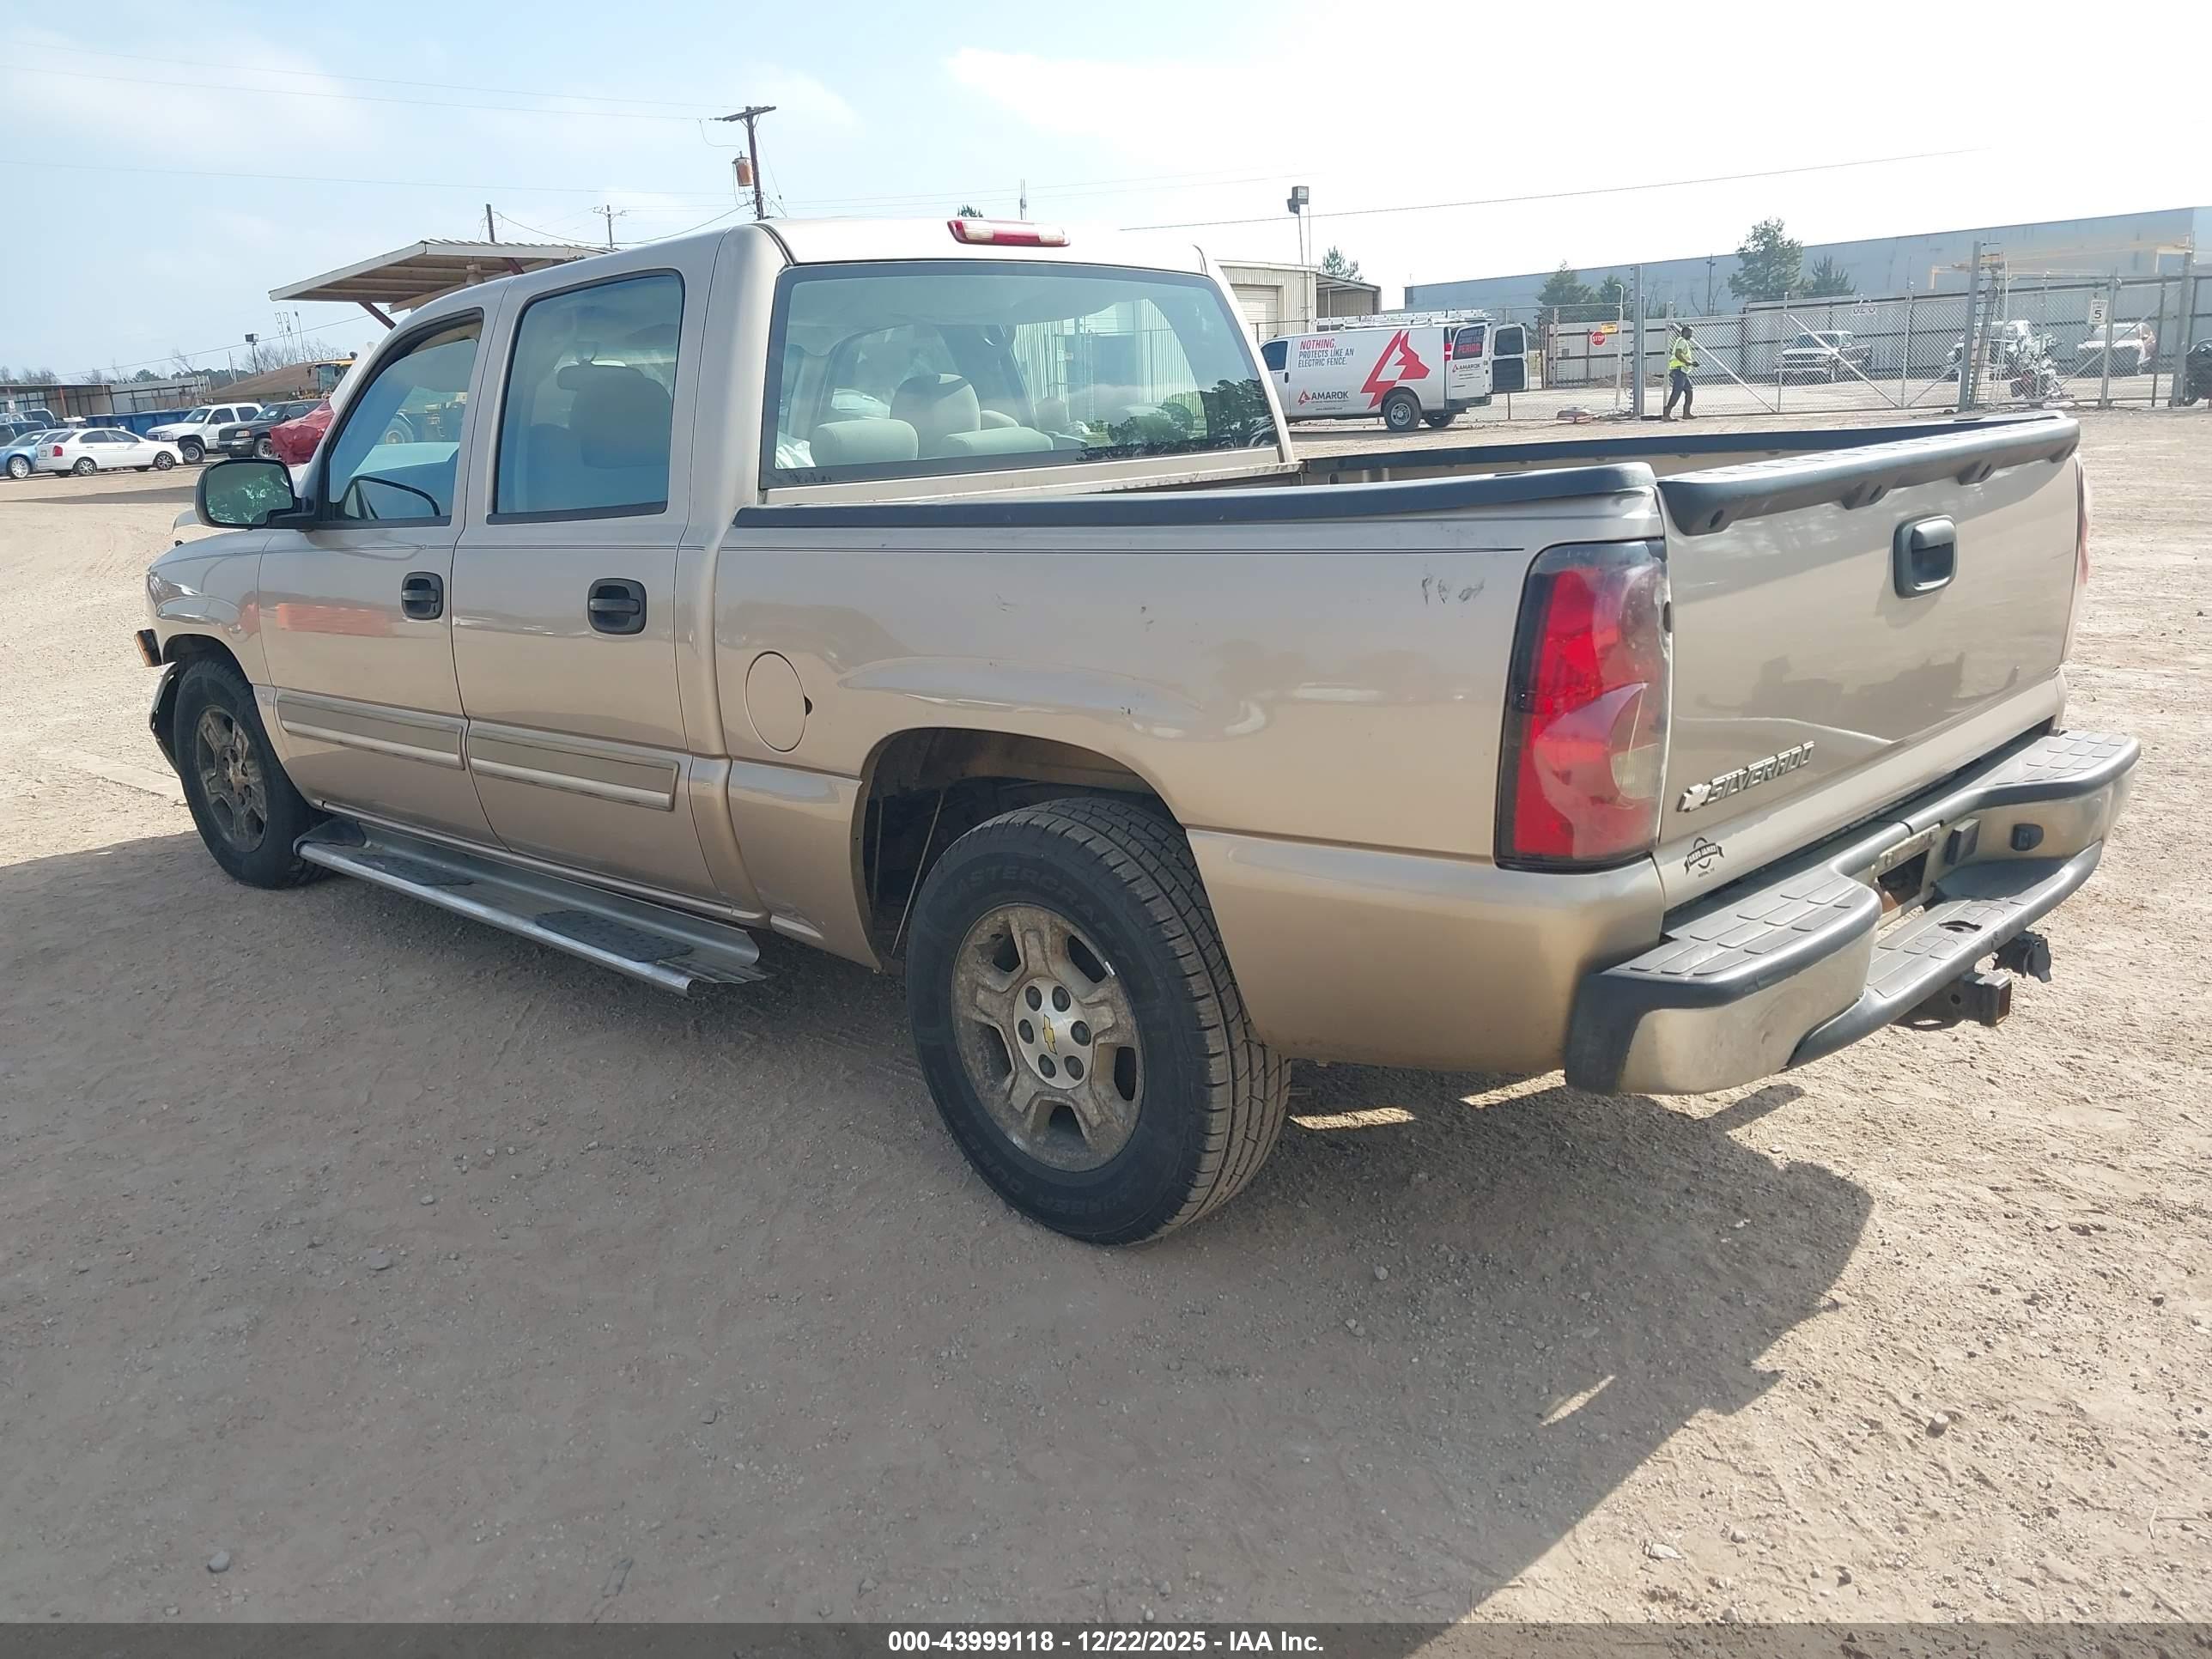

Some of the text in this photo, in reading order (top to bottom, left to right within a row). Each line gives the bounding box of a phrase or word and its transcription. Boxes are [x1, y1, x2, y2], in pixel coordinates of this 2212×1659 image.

[2094, 309, 2102, 319] 5
[1298, 348, 1354, 360] PROTECTS LIKE AN
[1297, 357, 1347, 368] ELECTRIC FENCE.
[1311, 391, 1349, 400] AMAROK
[1706, 740, 1814, 805] SILVERADO
